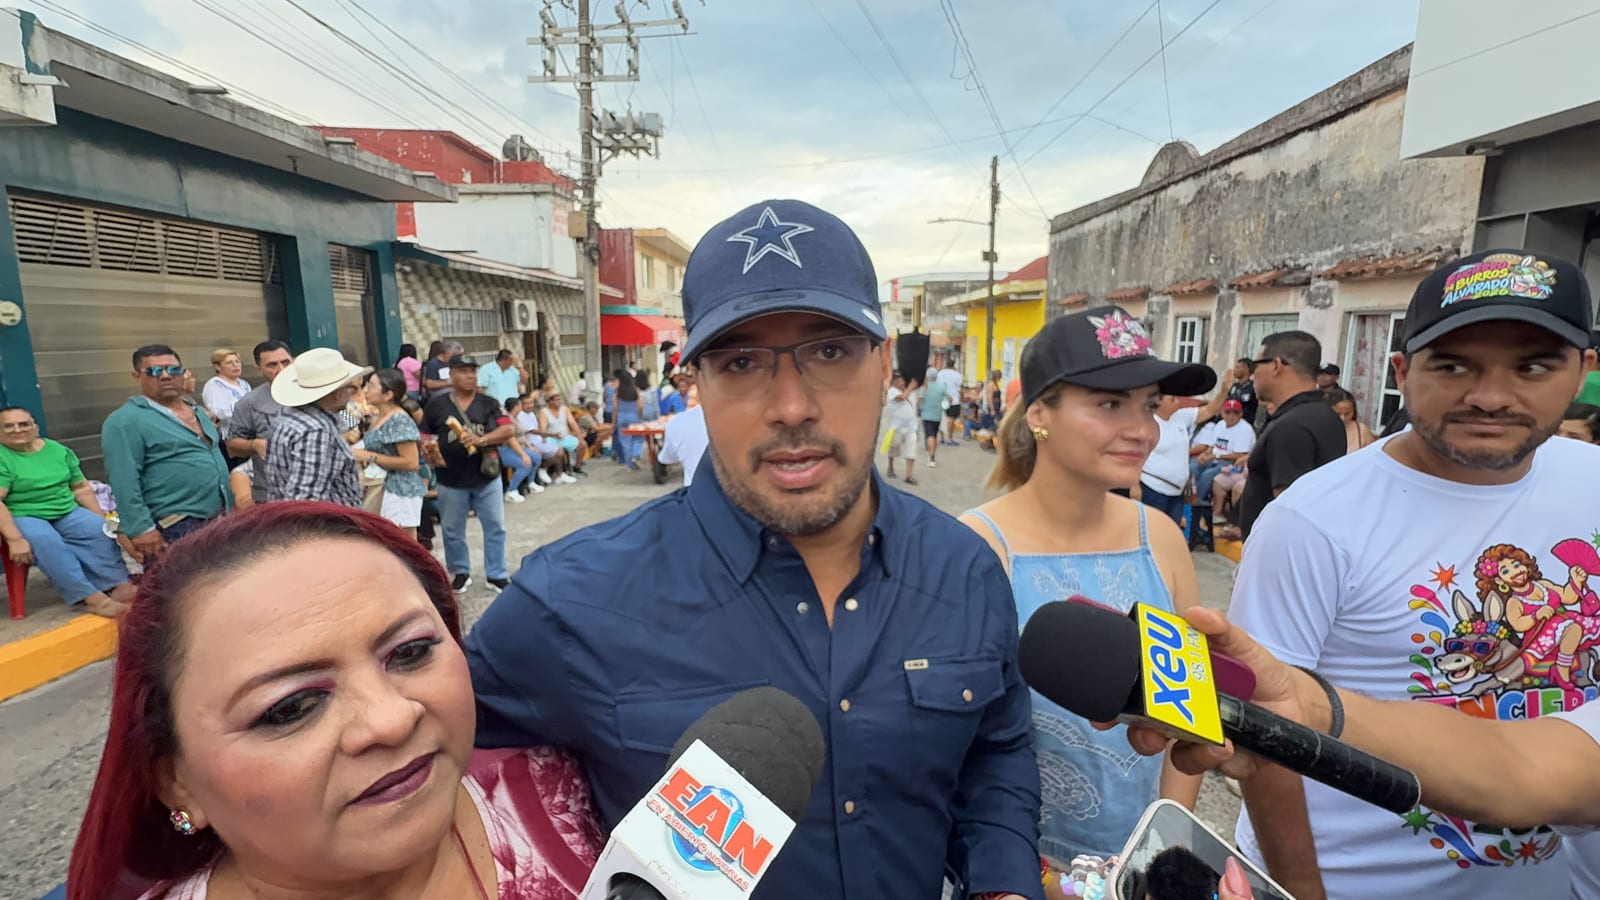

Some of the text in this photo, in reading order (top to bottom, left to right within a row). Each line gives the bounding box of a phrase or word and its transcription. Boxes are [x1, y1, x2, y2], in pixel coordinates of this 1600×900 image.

[1441, 278, 1509, 308] ALVARADO
[1456, 268, 1509, 290] BURROS
[647, 799, 665, 814] EN
[707, 851, 750, 891] NOTICIAS
[657, 767, 774, 876] EAN
